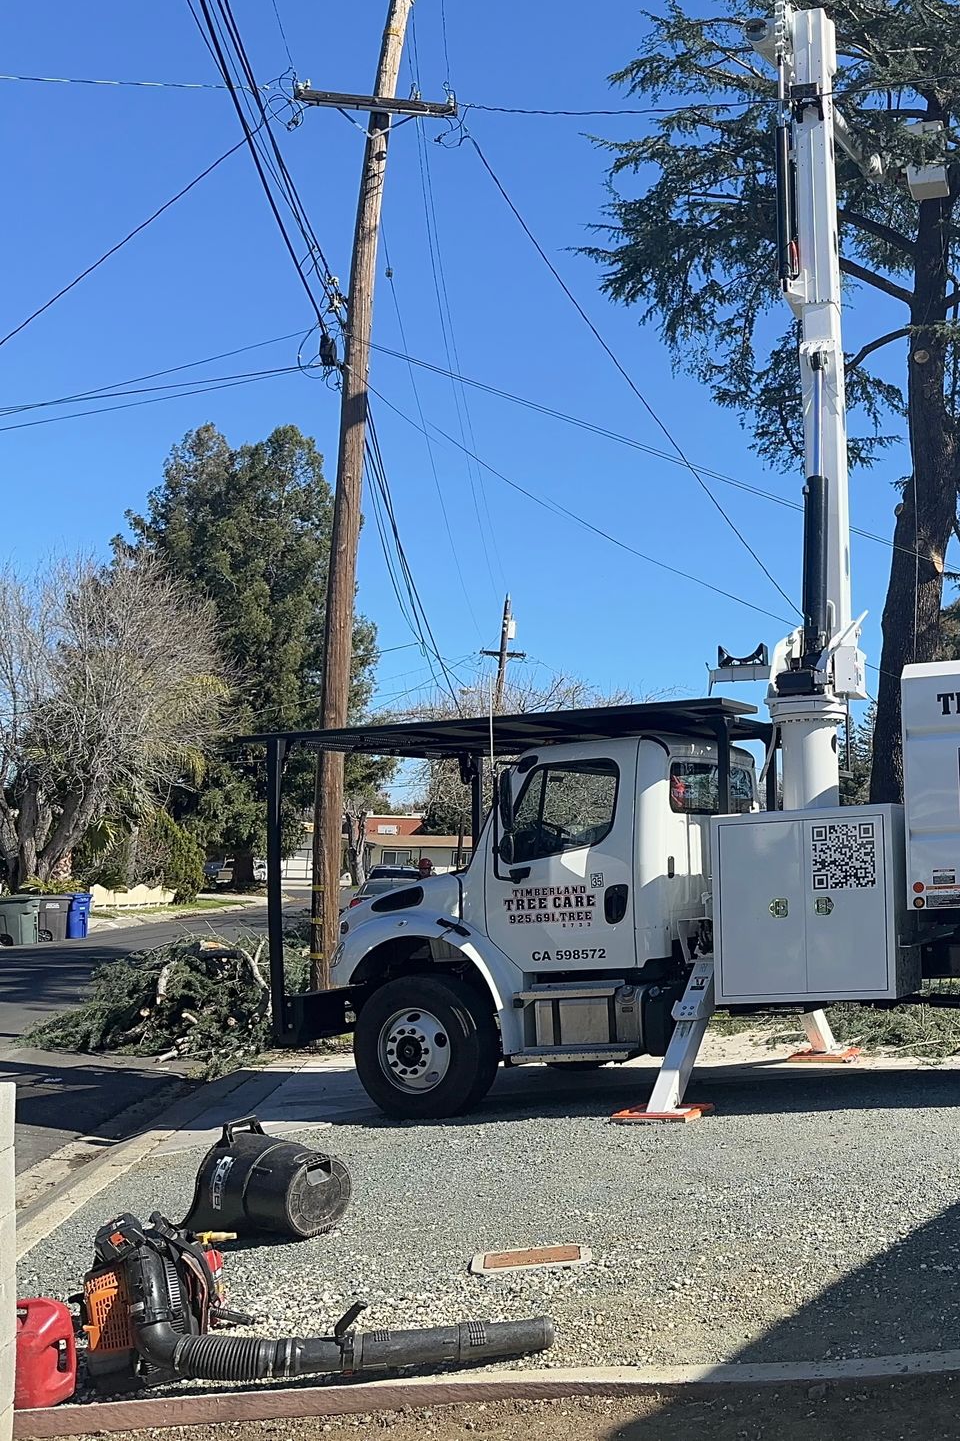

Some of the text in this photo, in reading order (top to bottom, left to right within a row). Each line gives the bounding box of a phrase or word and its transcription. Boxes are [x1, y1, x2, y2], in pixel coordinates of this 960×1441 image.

[592, 876, 602, 887] 35
[512, 885, 587, 898] TIMBERLAND
[504, 894, 596, 911] TREE CARE
[509, 911, 593, 925] 925.691.TREE
[532, 948, 607, 961] CA 598572
